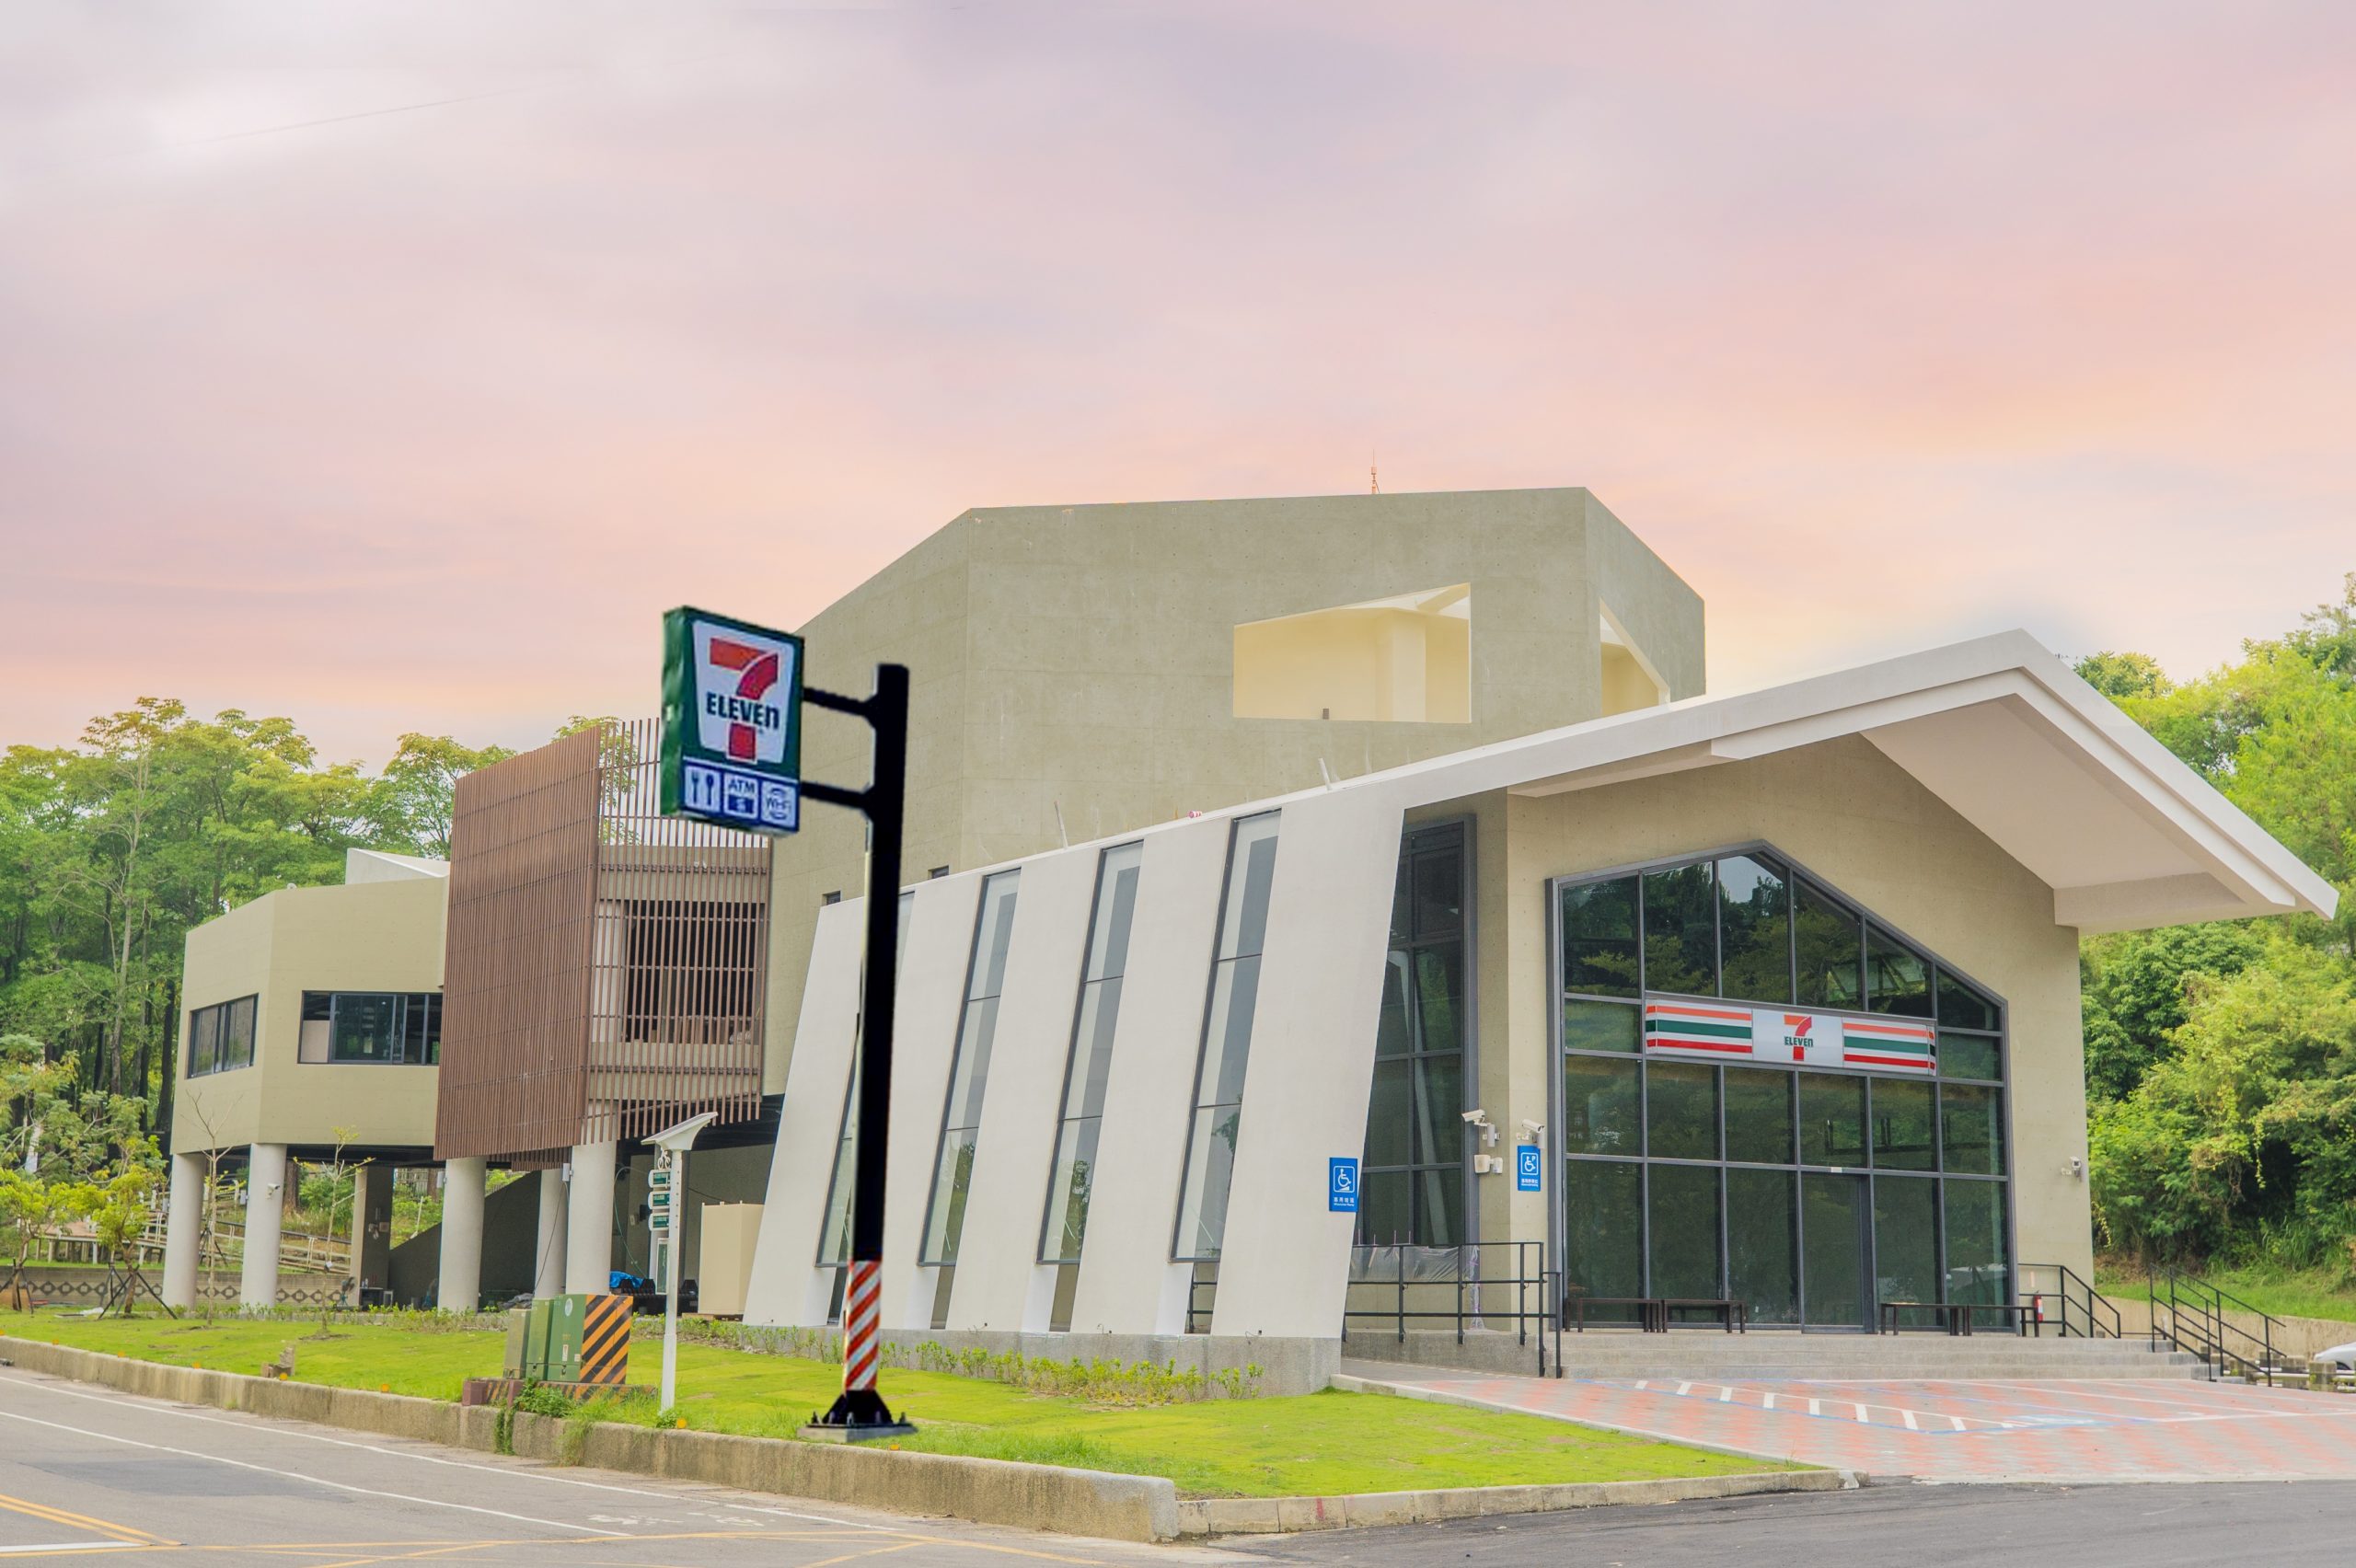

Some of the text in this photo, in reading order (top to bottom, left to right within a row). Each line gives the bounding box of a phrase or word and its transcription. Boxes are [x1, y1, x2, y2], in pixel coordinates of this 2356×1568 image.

[710, 637, 779, 761] 7
[728, 778, 755, 794] ATM
[1784, 1014, 1812, 1061] 7
